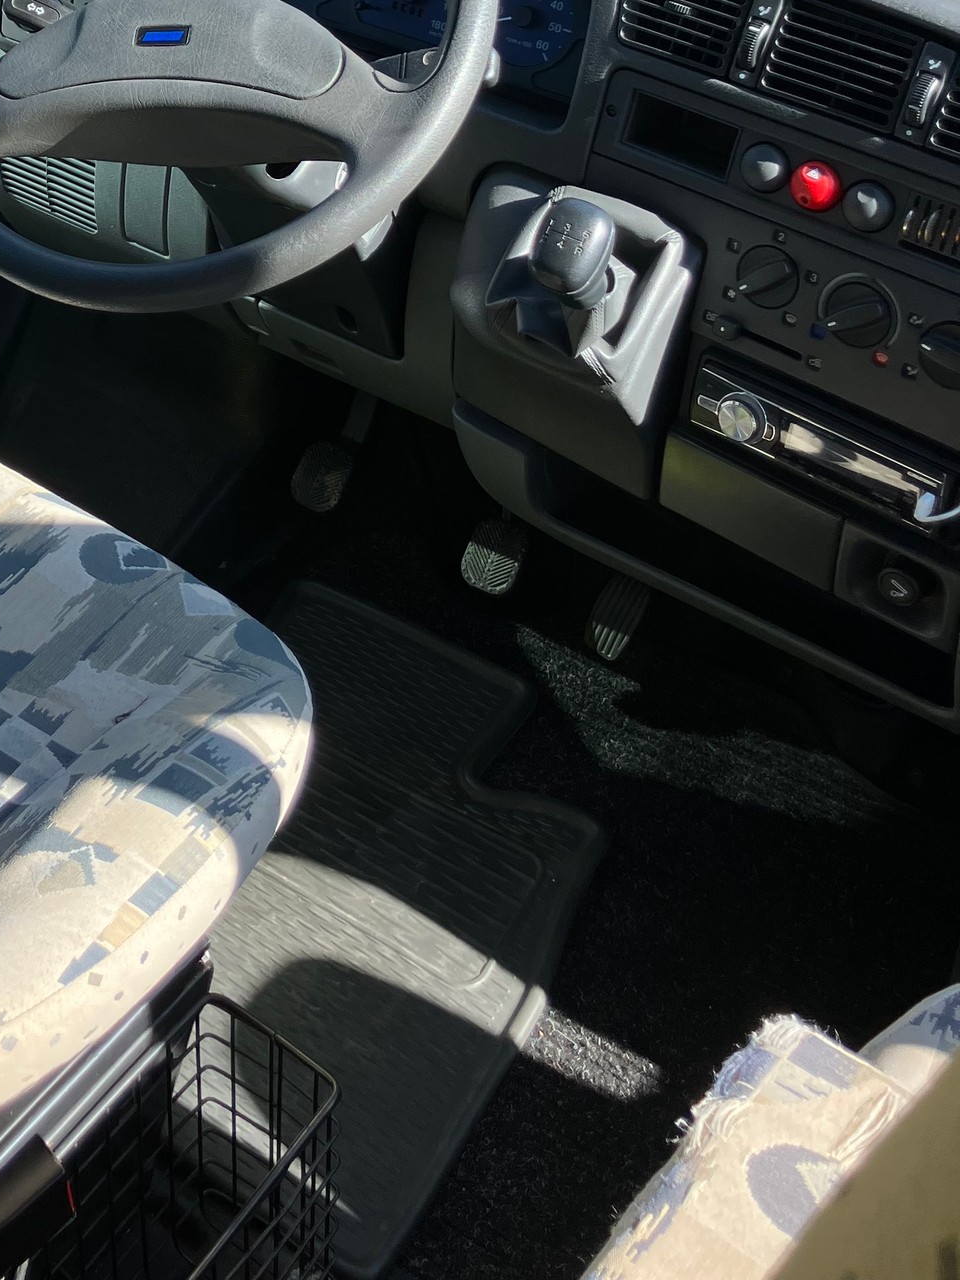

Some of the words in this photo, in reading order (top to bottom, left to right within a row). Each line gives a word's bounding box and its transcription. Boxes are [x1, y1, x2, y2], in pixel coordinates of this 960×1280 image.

[550, 0, 564, 11] 40
[548, 22, 562, 33] 50
[535, 40, 549, 51] 60
[777, 232, 785, 242] 2
[732, 242, 738, 250] 1
[809, 273, 818, 283] 3
